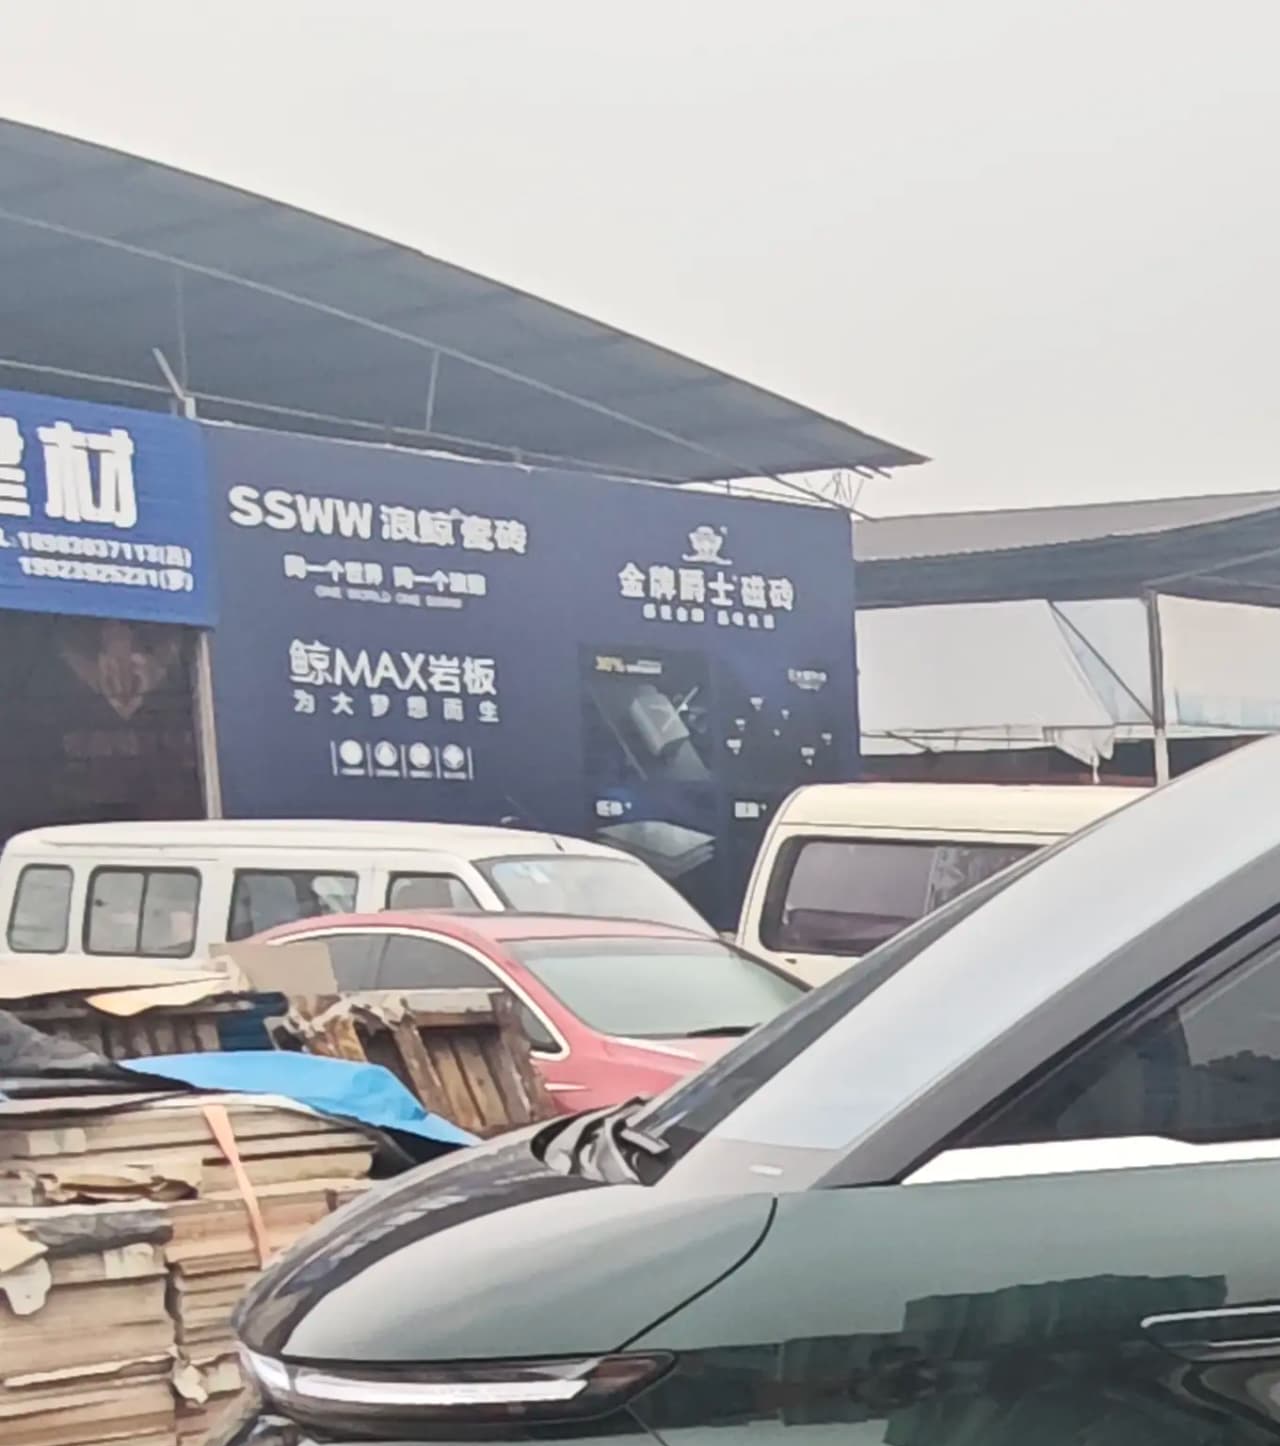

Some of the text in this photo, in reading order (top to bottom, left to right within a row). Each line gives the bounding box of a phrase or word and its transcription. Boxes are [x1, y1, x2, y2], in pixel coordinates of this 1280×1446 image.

[228, 485, 372, 539] SSWW
[289, 638, 497, 696] 鲸MAX岩板
